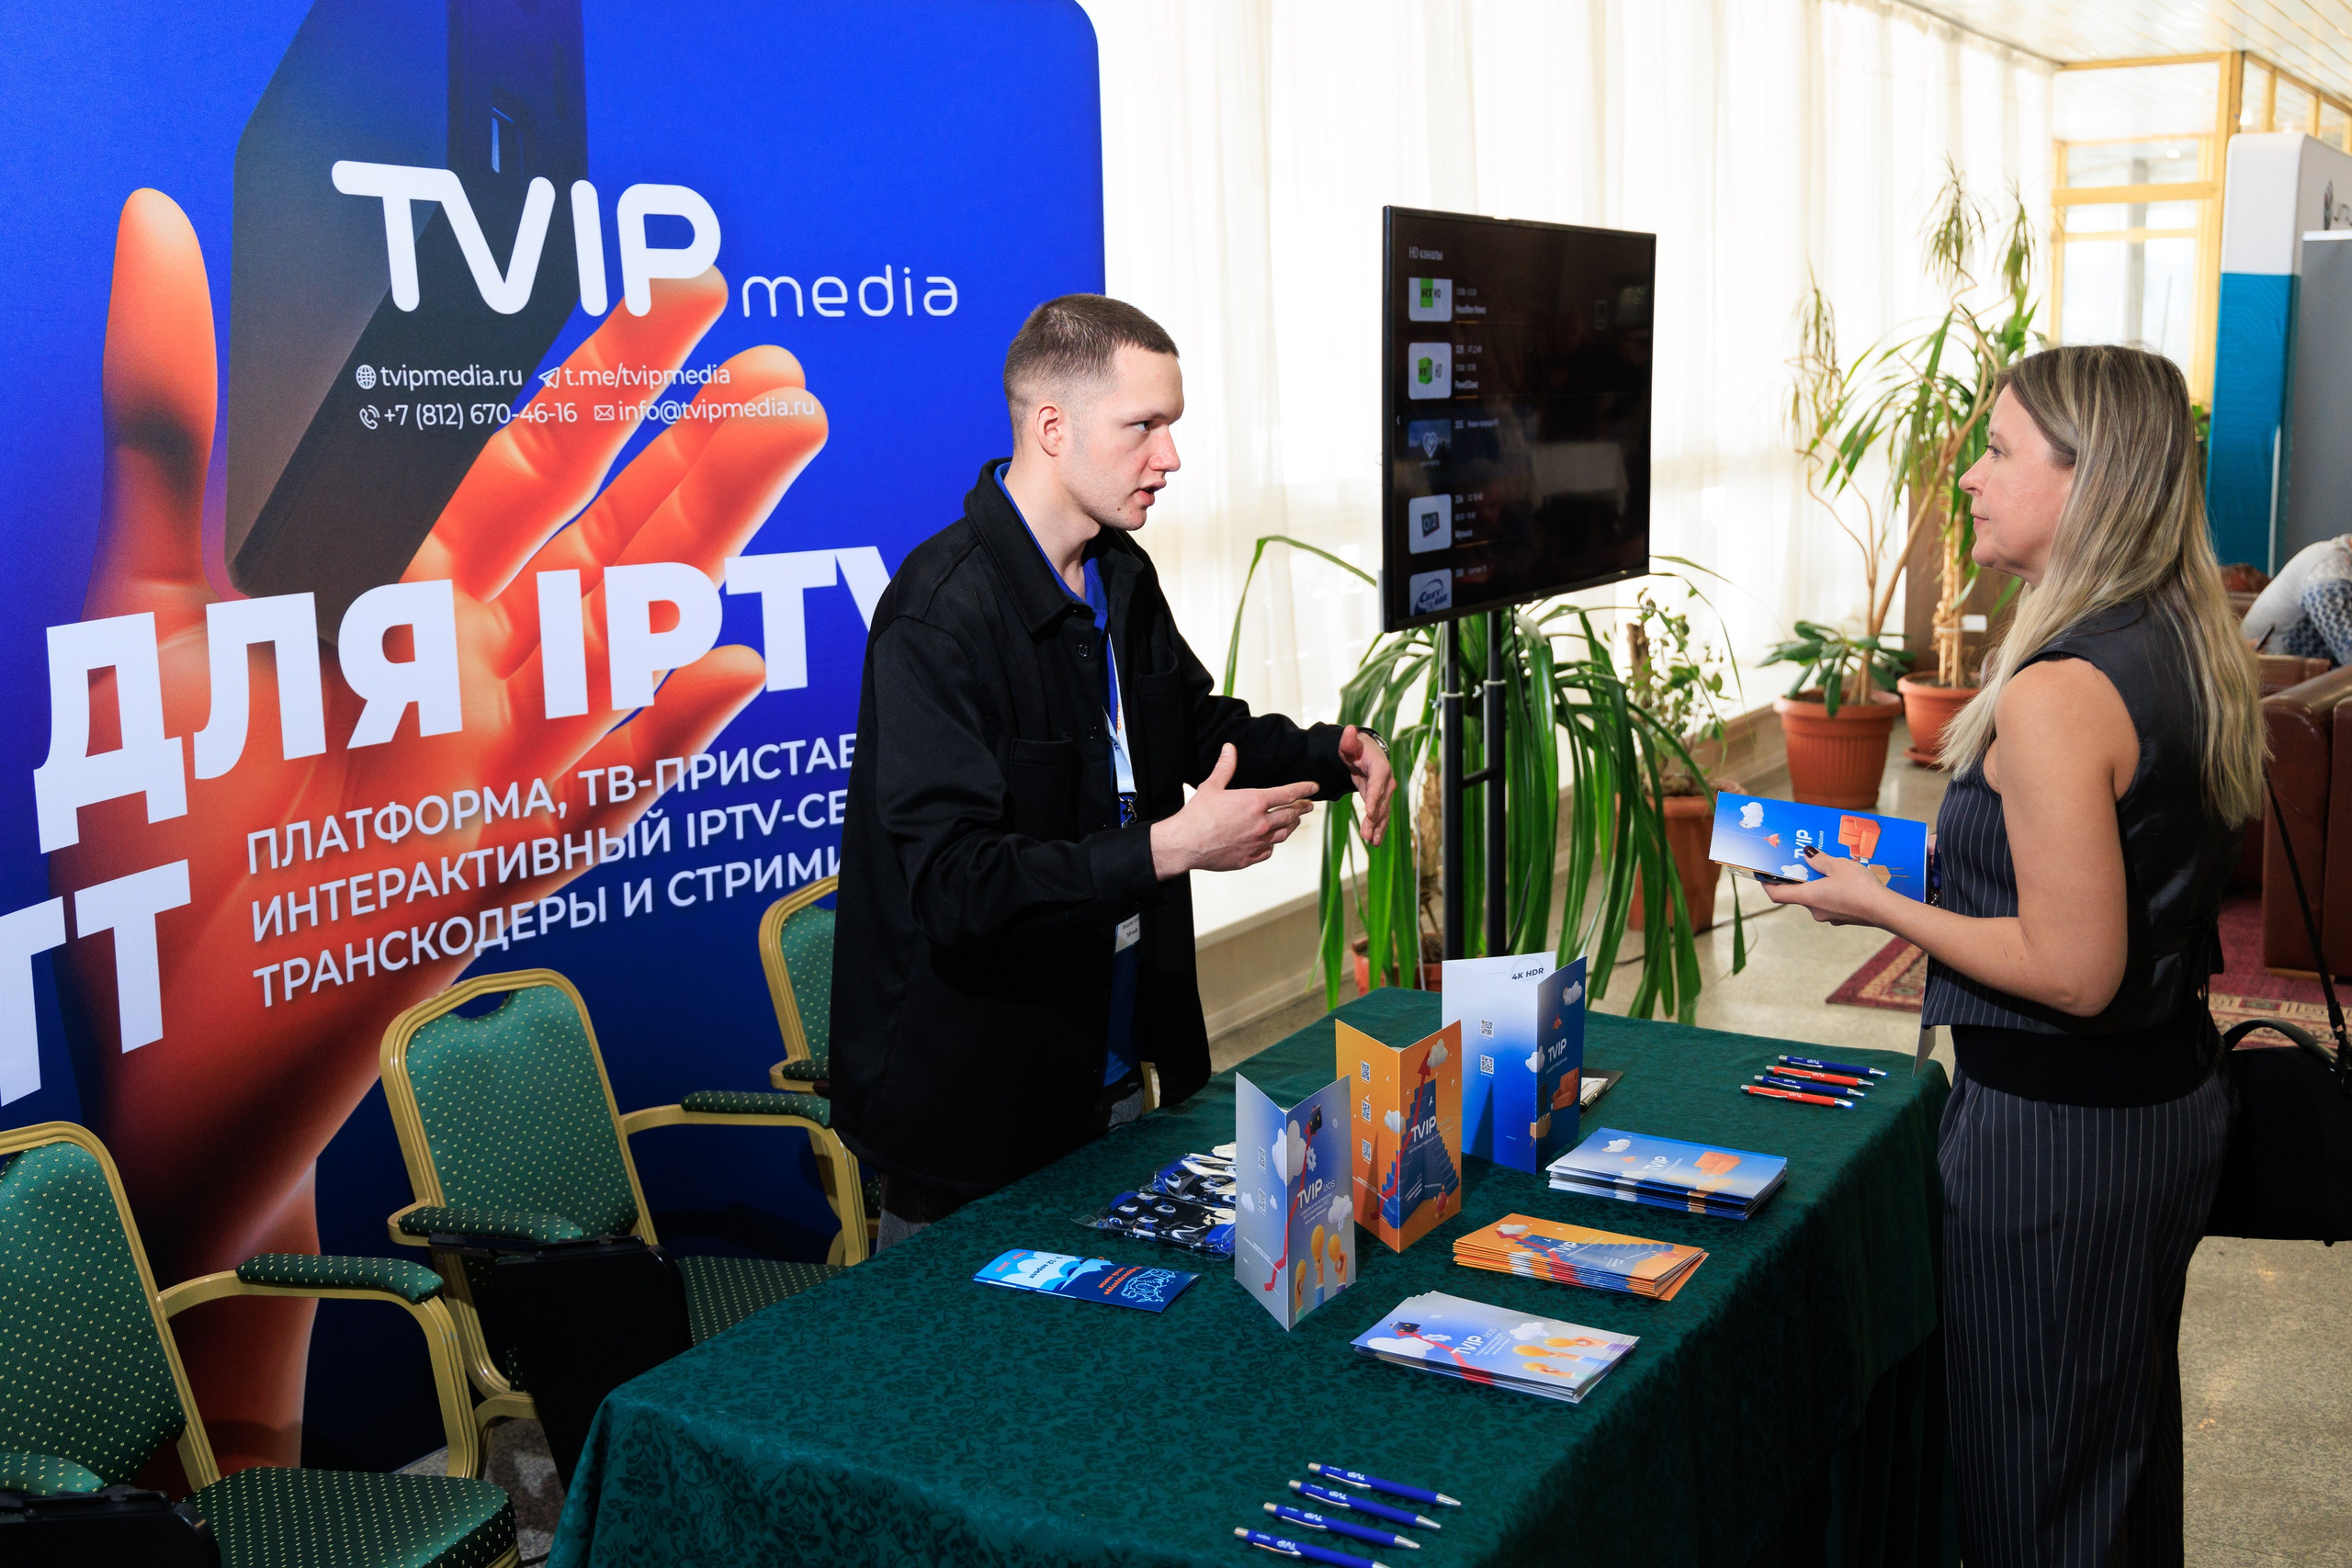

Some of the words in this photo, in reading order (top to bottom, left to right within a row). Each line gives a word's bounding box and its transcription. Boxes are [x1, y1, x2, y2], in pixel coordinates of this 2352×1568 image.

[332, 160, 722, 317] TVIP
[741, 264, 959, 318] media
[379, 364, 523, 391] tvipmedia.ru
[563, 361, 732, 389] t.me/tvipmedia
[383, 405, 410, 426] +7
[415, 402, 465, 431] (812)
[469, 401, 579, 425] 670-46-16
[617, 398, 816, 426] info@tvipmedia.ru
[34, 579, 464, 854] ДЛЯ
[536, 545, 890, 721] IPT
[245, 774, 568, 874] ПЛАТФОРМА,
[251, 809, 673, 942] ИНТЕРАКТИВНЫЙ
[253, 887, 608, 1009] ТРАНСКОДЕРЫ
[624, 878, 655, 919] И
[1511, 972, 1523, 980] 4K
[1525, 967, 1544, 977] HDR
[1547, 1037, 1567, 1062] TVIP
[1410, 1115, 1437, 1143] TVIP
[1643, 1156, 1669, 1170] TVIP
[1296, 1178, 1323, 1209] TVIP
[1546, 1241, 1578, 1255] TVIP
[1451, 1335, 1485, 1355] TVIP
[1347, 1471, 1365, 1481] TVIP
[1329, 1490, 1347, 1501] TVIP
[1304, 1512, 1323, 1522] TVIP
[1276, 1540, 1296, 1551] TVIP
